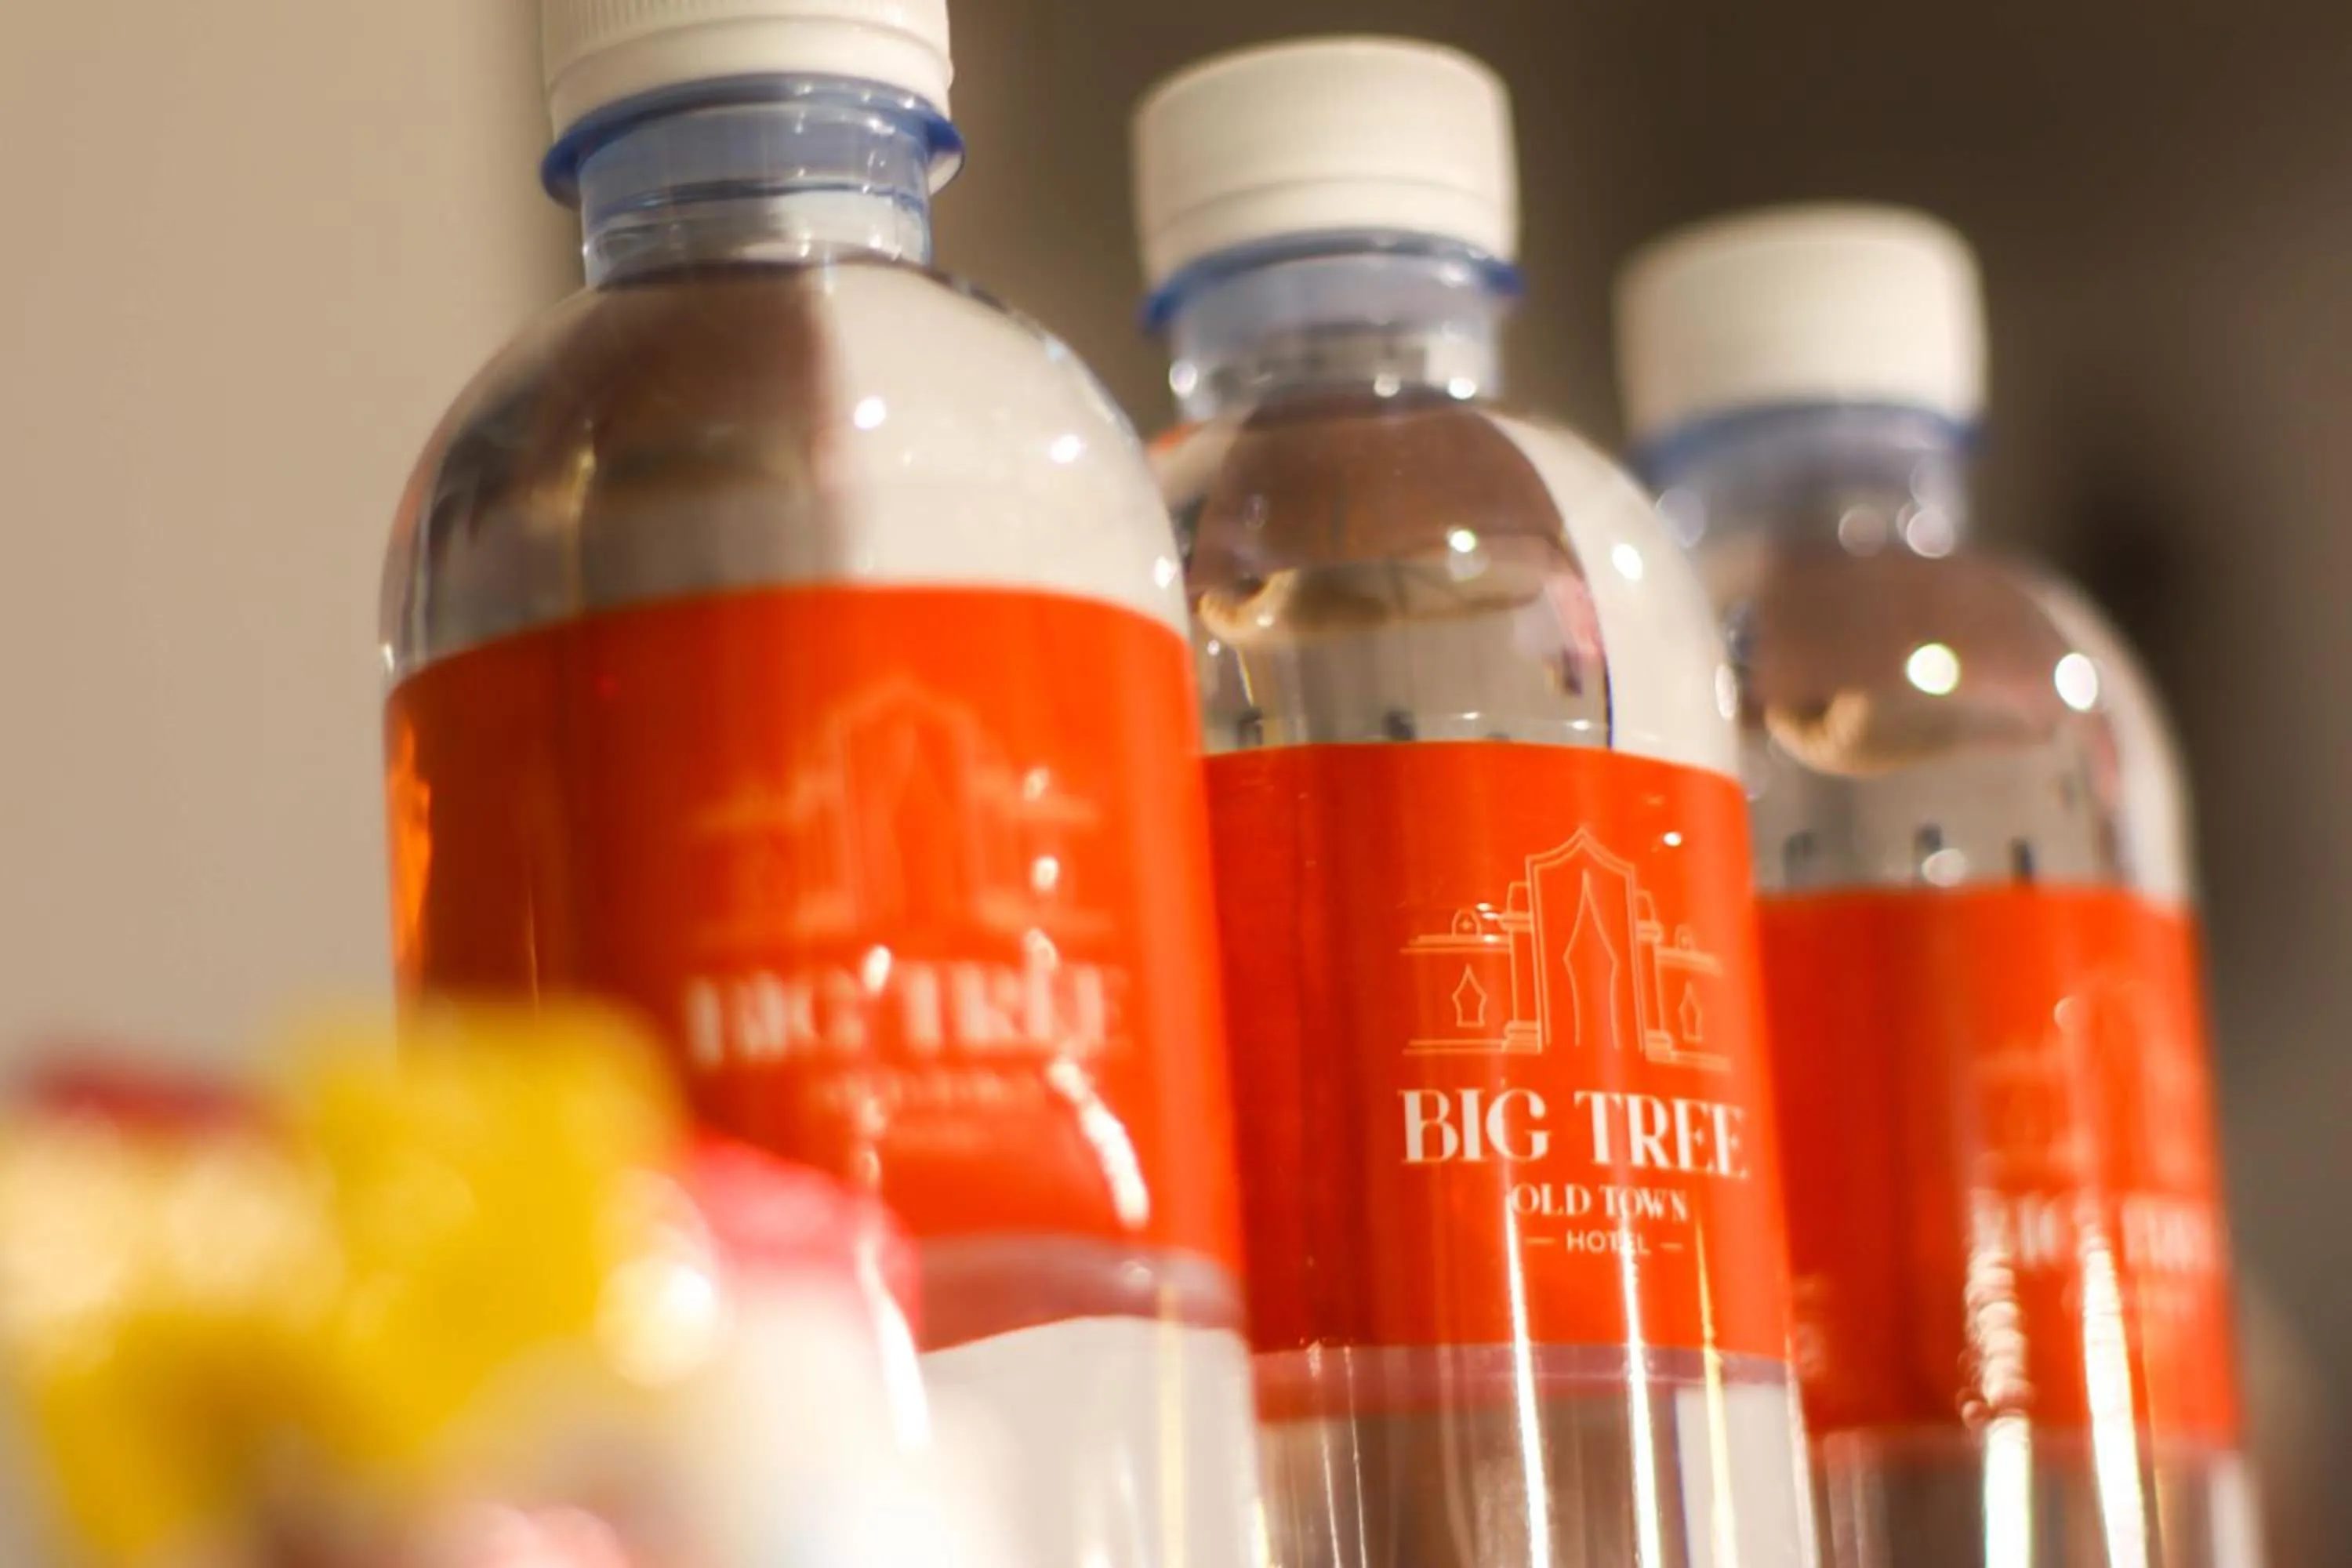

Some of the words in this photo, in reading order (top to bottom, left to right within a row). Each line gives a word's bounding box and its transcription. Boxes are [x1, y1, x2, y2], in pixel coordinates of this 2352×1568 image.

[1398, 1087, 1552, 1163] BIG
[1574, 1091, 1750, 1178] TREE
[1511, 1181, 1592, 1217] OLD
[1599, 1185, 1688, 1221] TOWN
